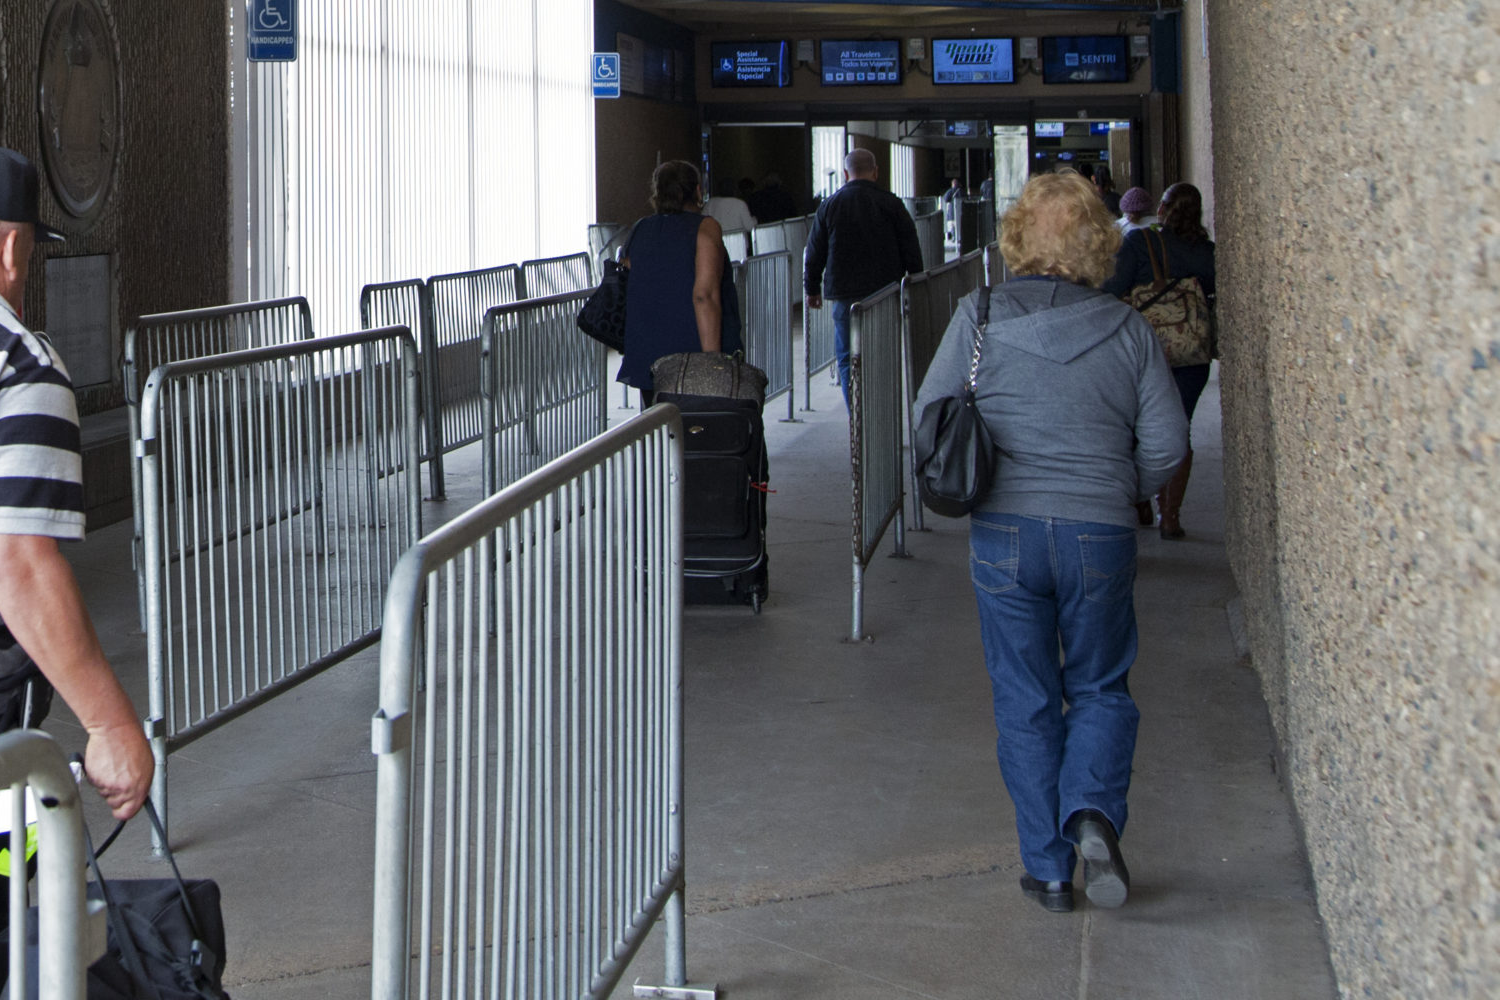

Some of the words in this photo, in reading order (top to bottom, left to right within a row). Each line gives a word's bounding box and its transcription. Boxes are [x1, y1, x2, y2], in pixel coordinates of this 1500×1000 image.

[250, 36, 294, 44] HANDICAPPED
[736, 50, 758, 58] Special
[851, 50, 882, 58] Travelers
[1081, 54, 1116, 64] SENTRI
